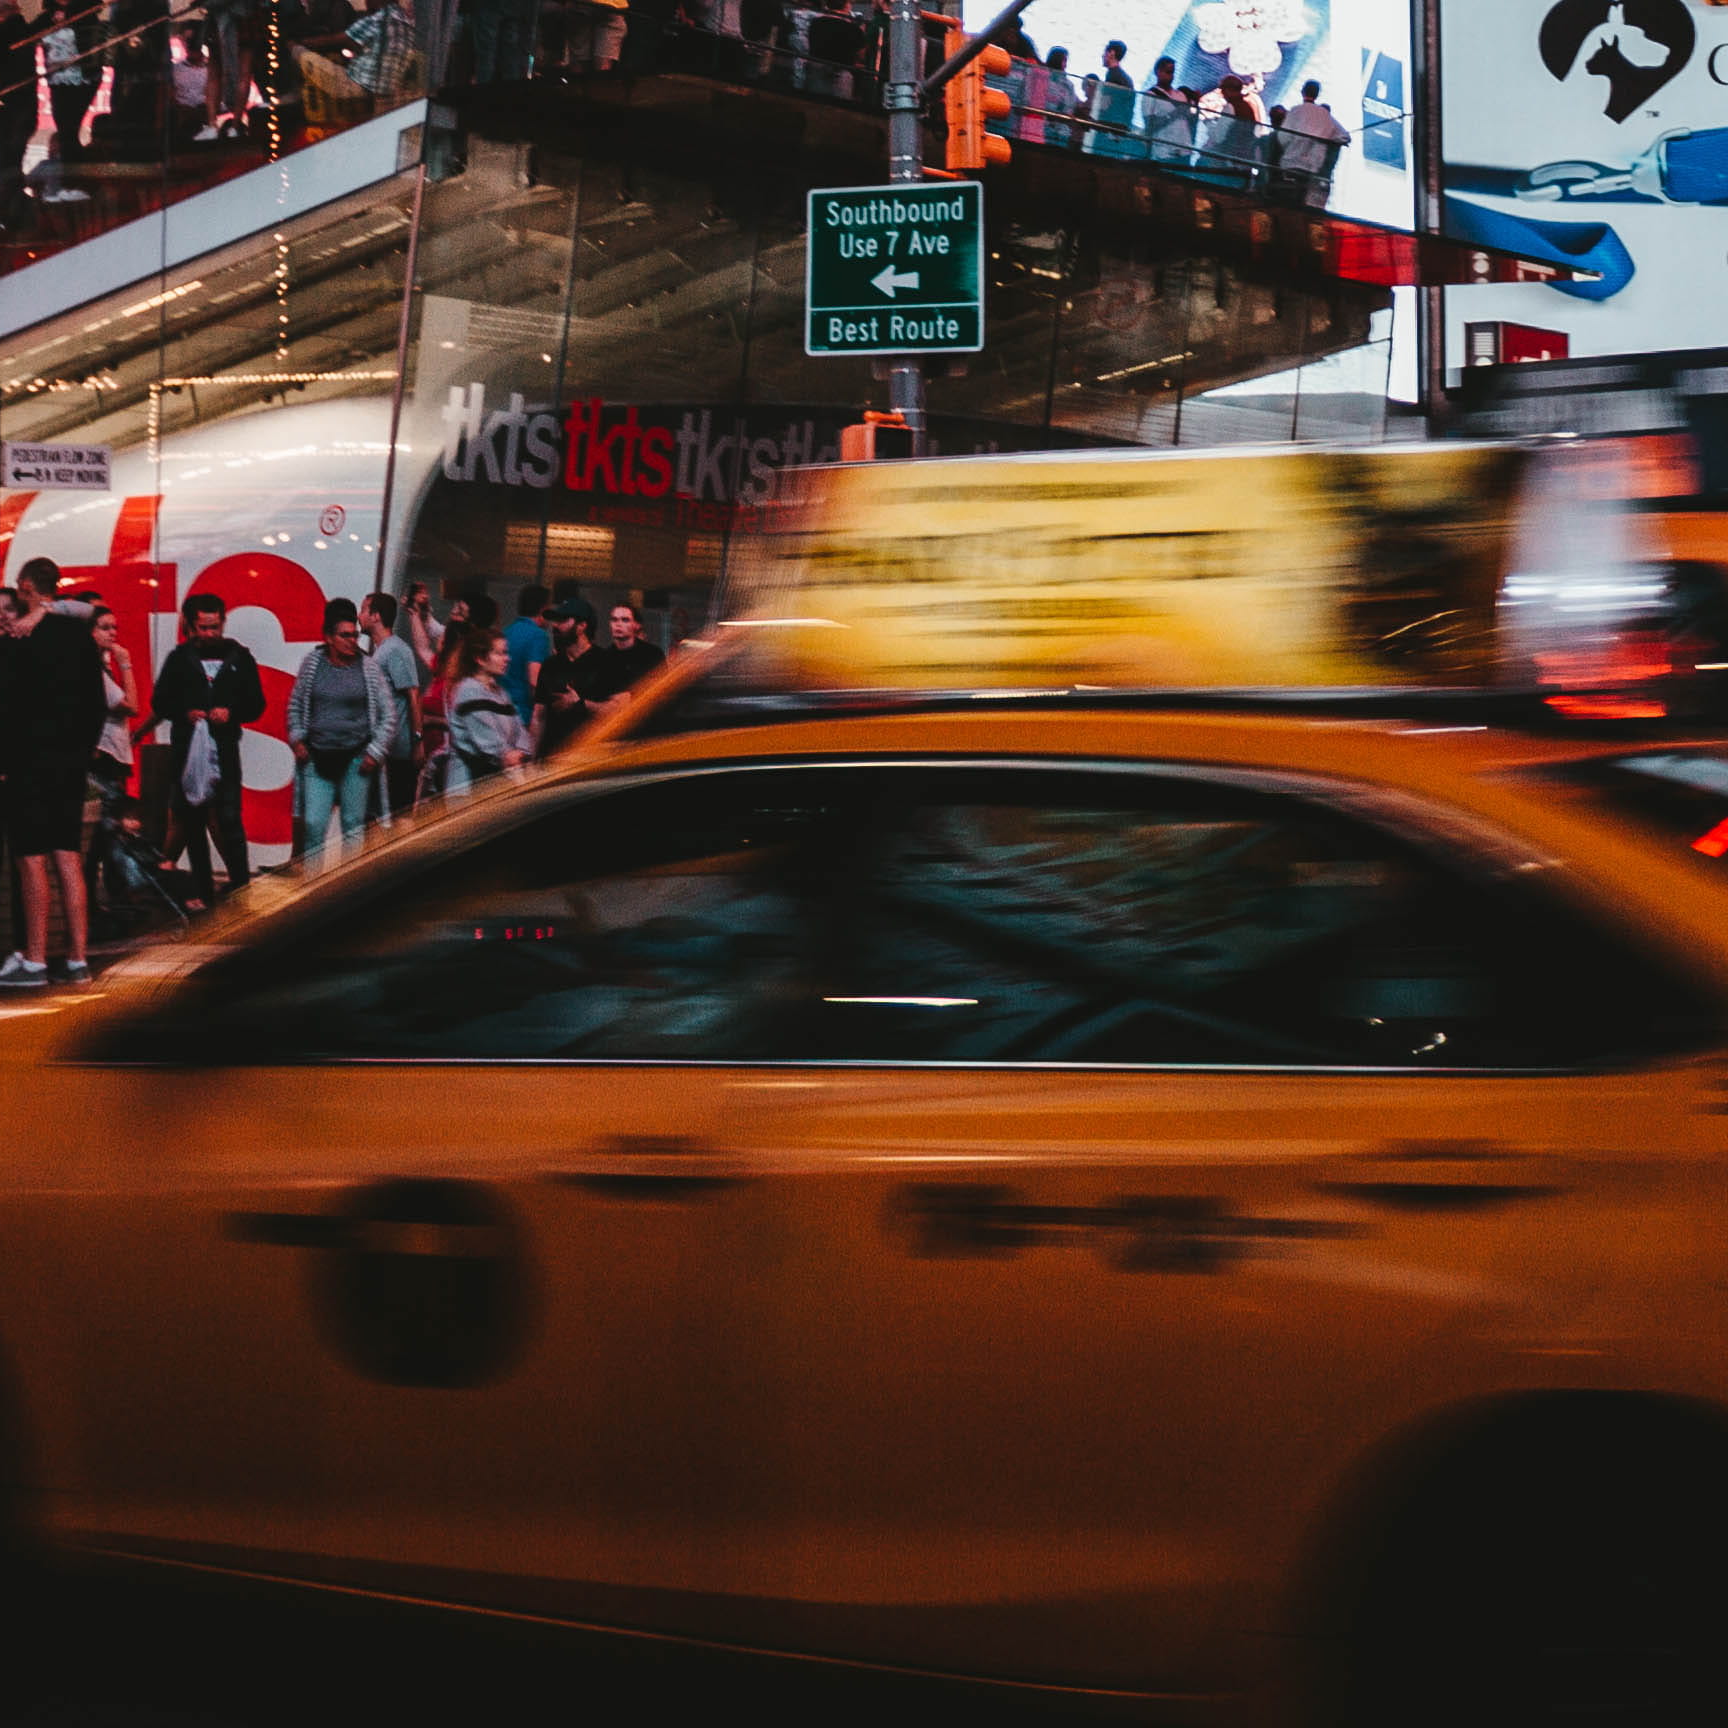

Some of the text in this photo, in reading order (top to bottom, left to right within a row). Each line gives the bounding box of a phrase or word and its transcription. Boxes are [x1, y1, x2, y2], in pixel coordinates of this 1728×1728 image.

[826, 196, 964, 226] Southbound
[839, 230, 950, 258] Use 7 Ave
[828, 315, 959, 343] Best Route
[440, 382, 560, 489] tkts
[563, 396, 671, 499] tkts
